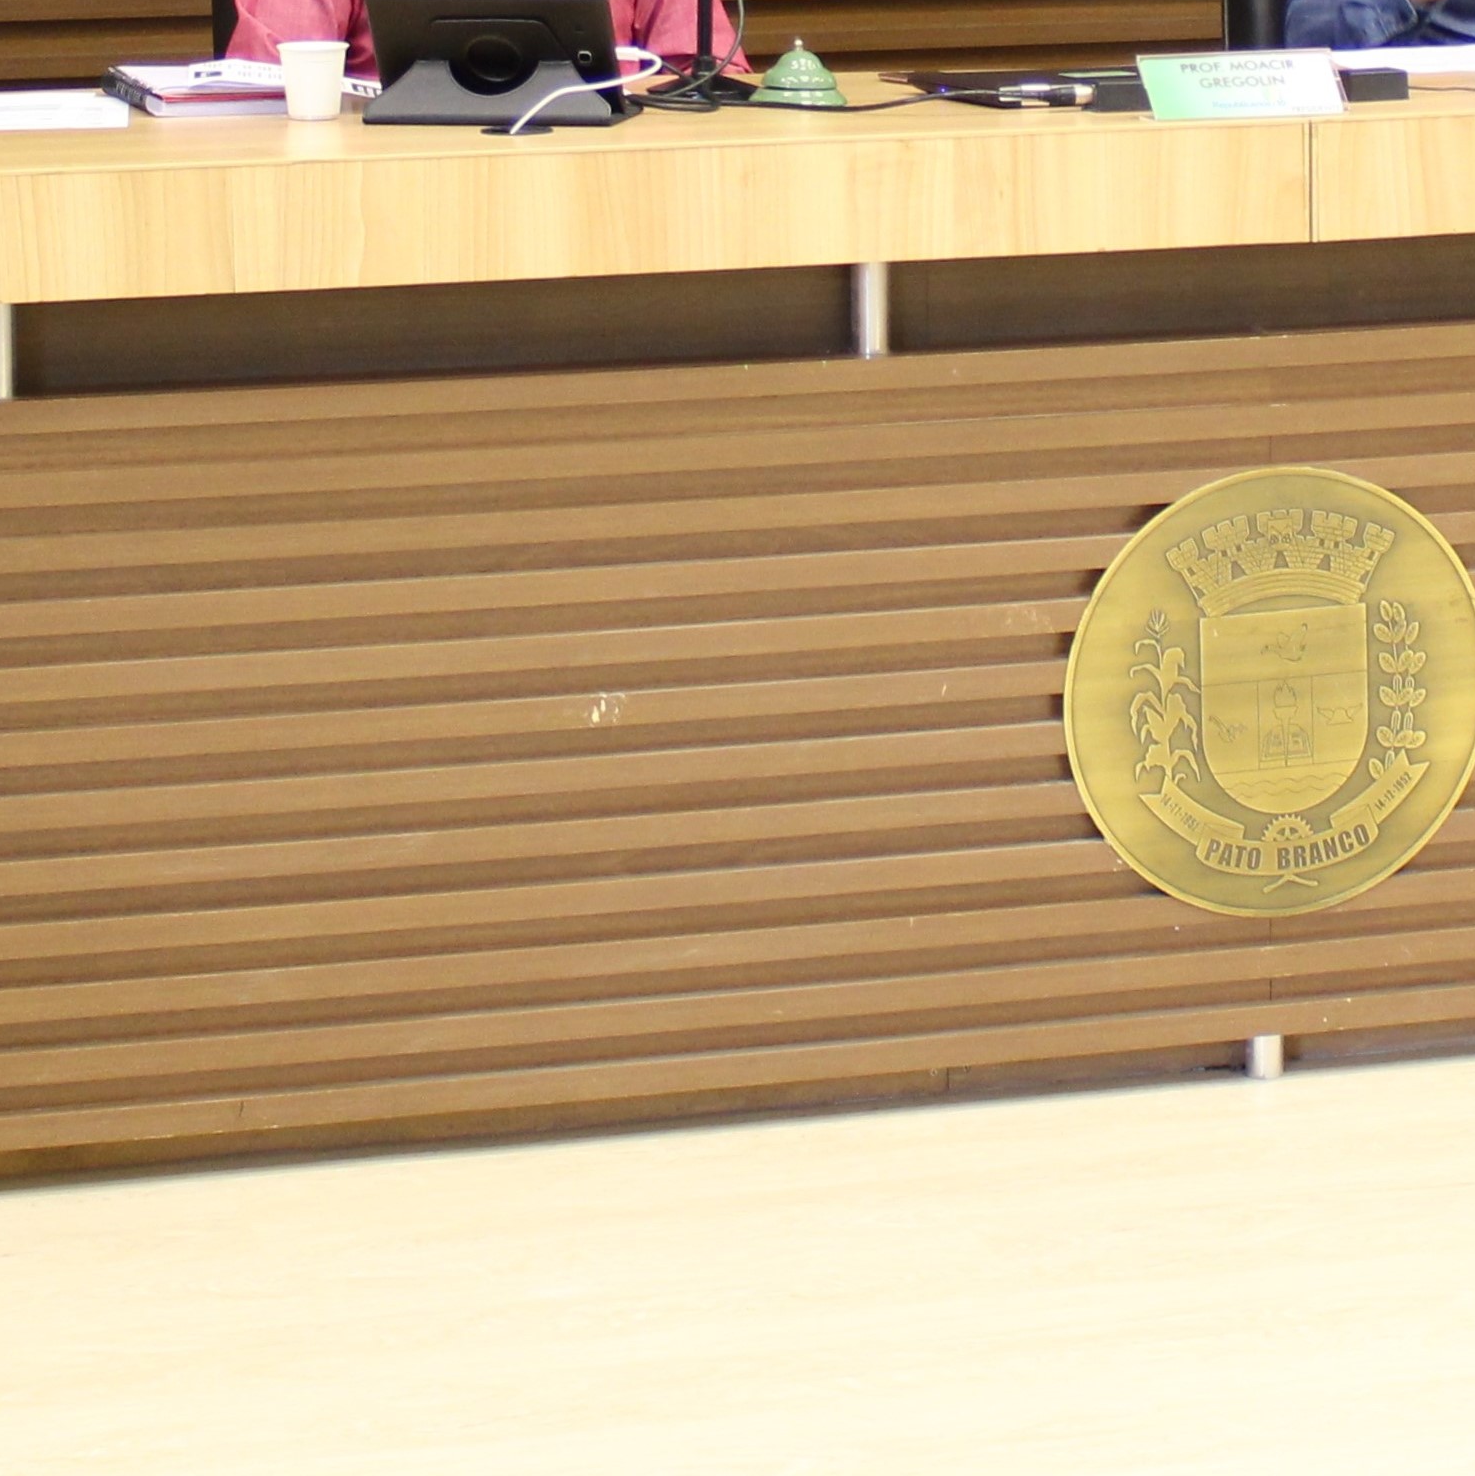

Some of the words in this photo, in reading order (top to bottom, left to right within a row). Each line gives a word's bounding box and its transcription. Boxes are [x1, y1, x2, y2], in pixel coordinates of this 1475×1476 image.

[1229, 59, 1293, 71] MOACIR
[1199, 75, 1285, 89] GREGOLIN
[1204, 838, 1262, 870] PATO
[1277, 823, 1370, 870] BRANCO
